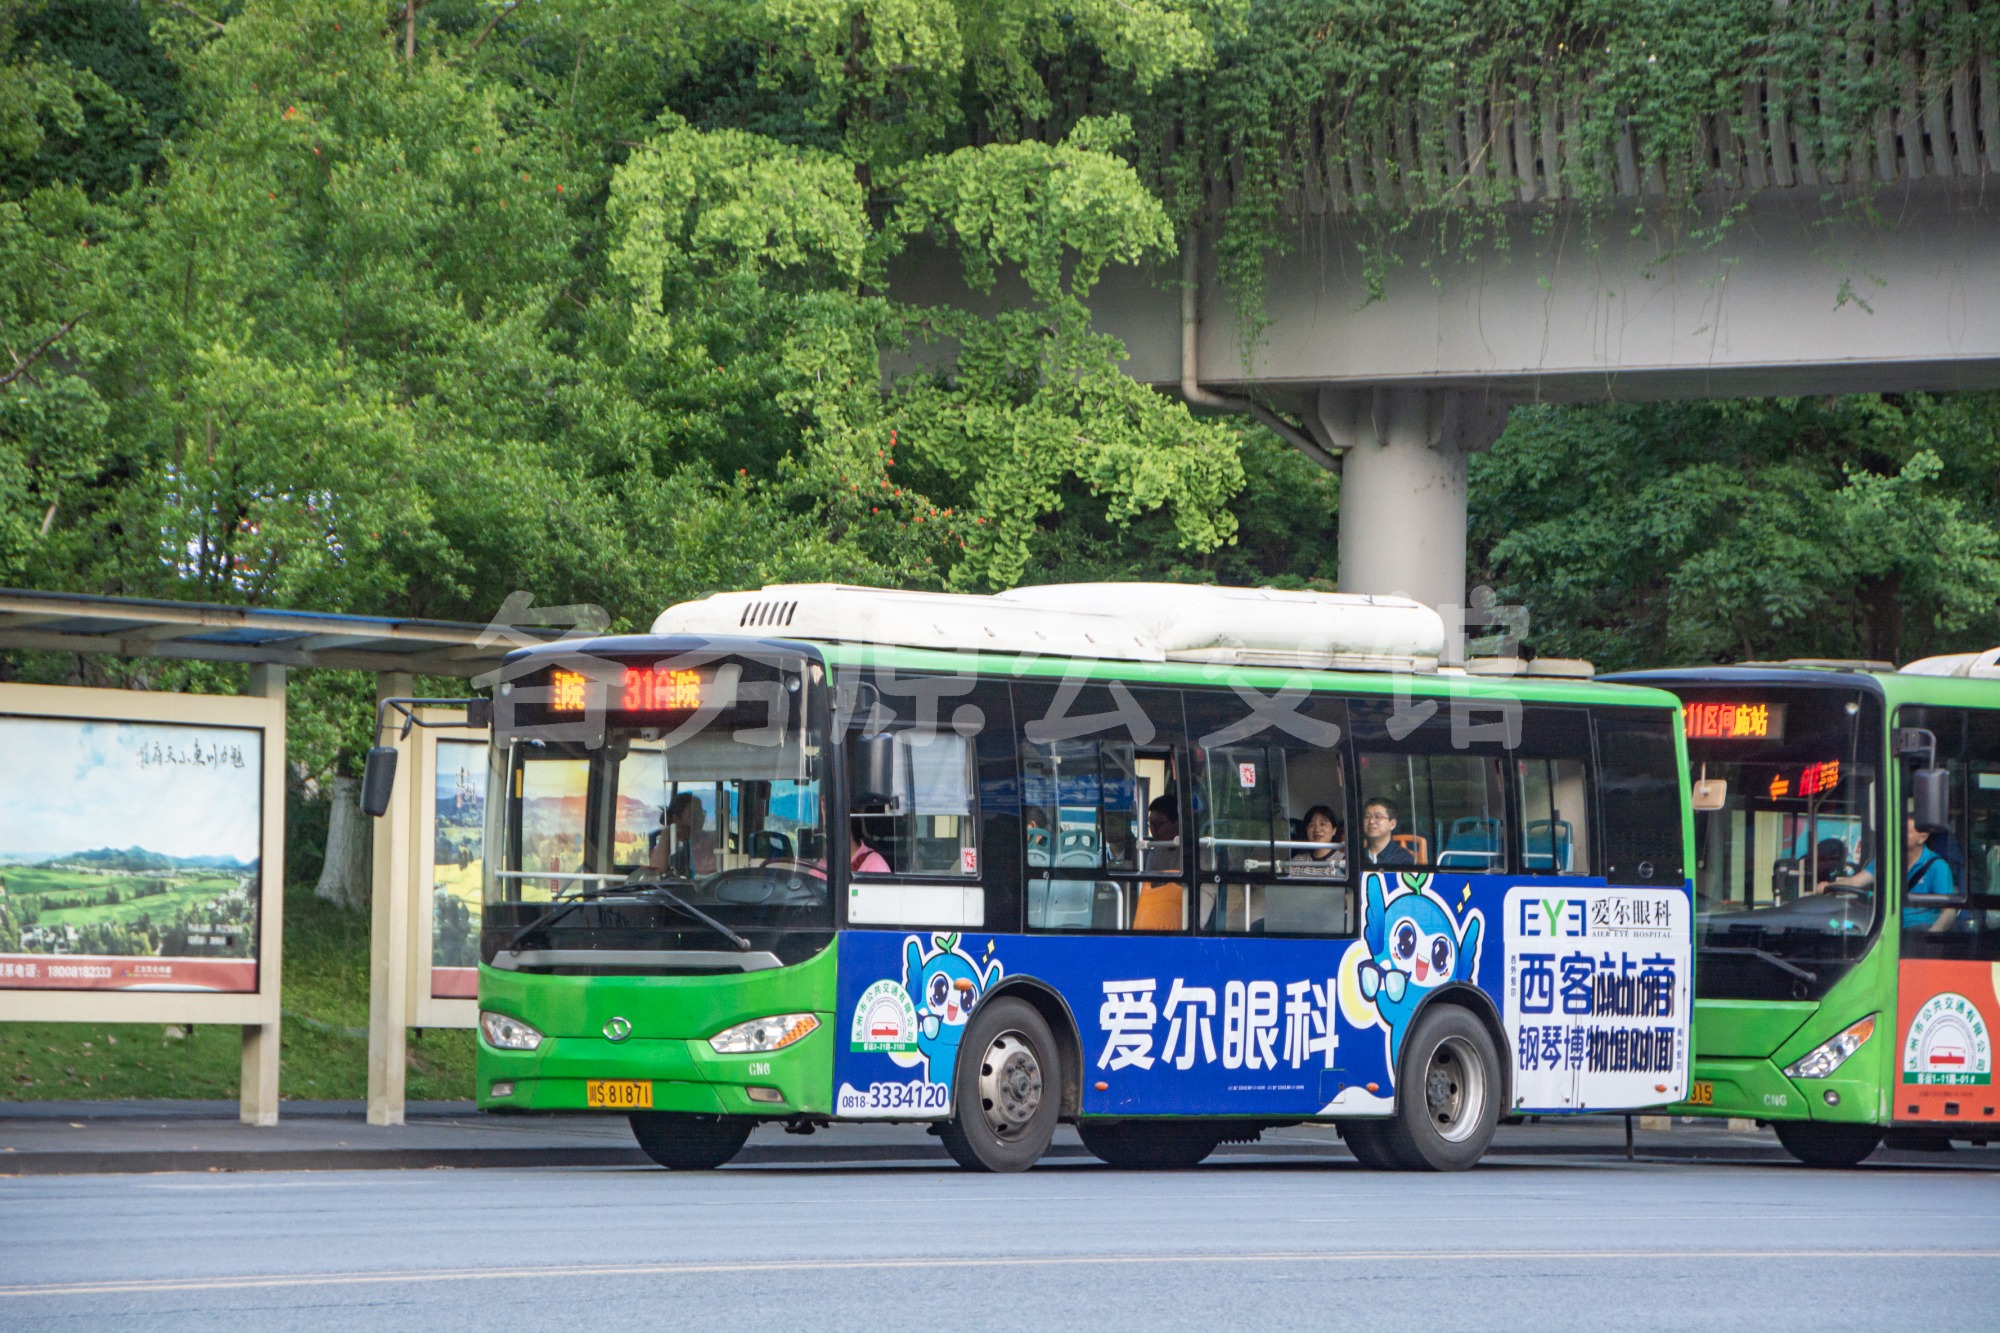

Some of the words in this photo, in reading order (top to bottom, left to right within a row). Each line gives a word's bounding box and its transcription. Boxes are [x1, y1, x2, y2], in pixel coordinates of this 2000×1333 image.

[1683, 703, 1768, 737] 11区间庙站
[1520, 898, 1587, 937] EYE
[1591, 898, 1672, 927] 爱尔眼科
[1097, 978, 1339, 1071] 爱尔眼科
[749, 1062, 770, 1075] CNG
[842, 1085, 946, 1108] 0818-3334120
[1763, 1093, 1787, 1106] CNG
